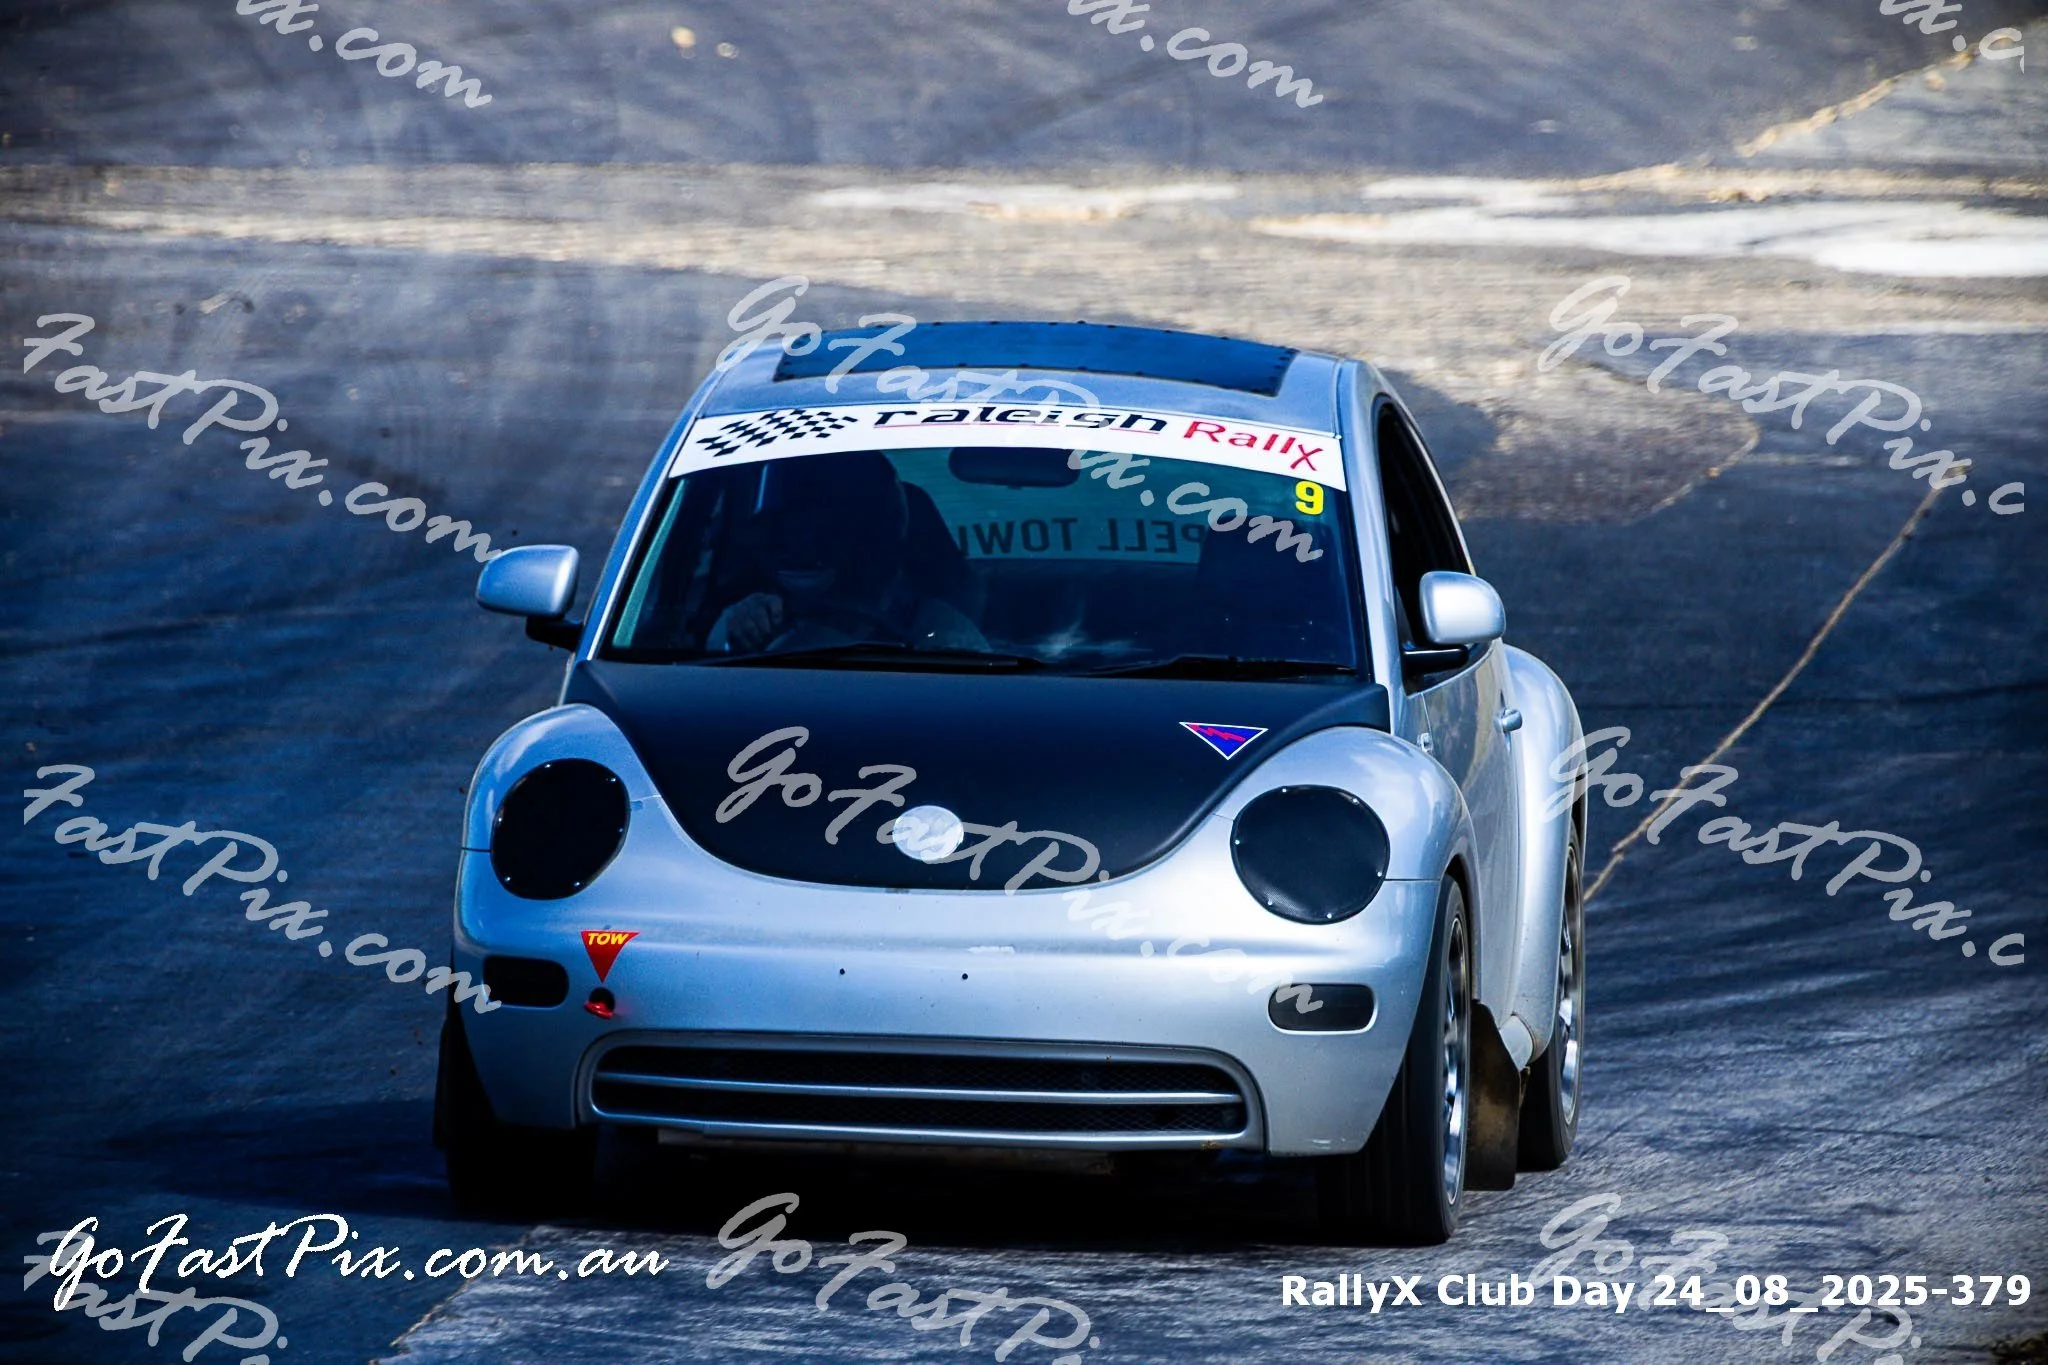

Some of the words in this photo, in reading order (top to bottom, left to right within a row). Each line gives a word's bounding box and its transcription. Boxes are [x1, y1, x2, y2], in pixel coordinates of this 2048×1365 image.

[874, 406, 1167, 432] raleigh
[1295, 480, 1324, 515] 9
[588, 933, 629, 946] TOW
